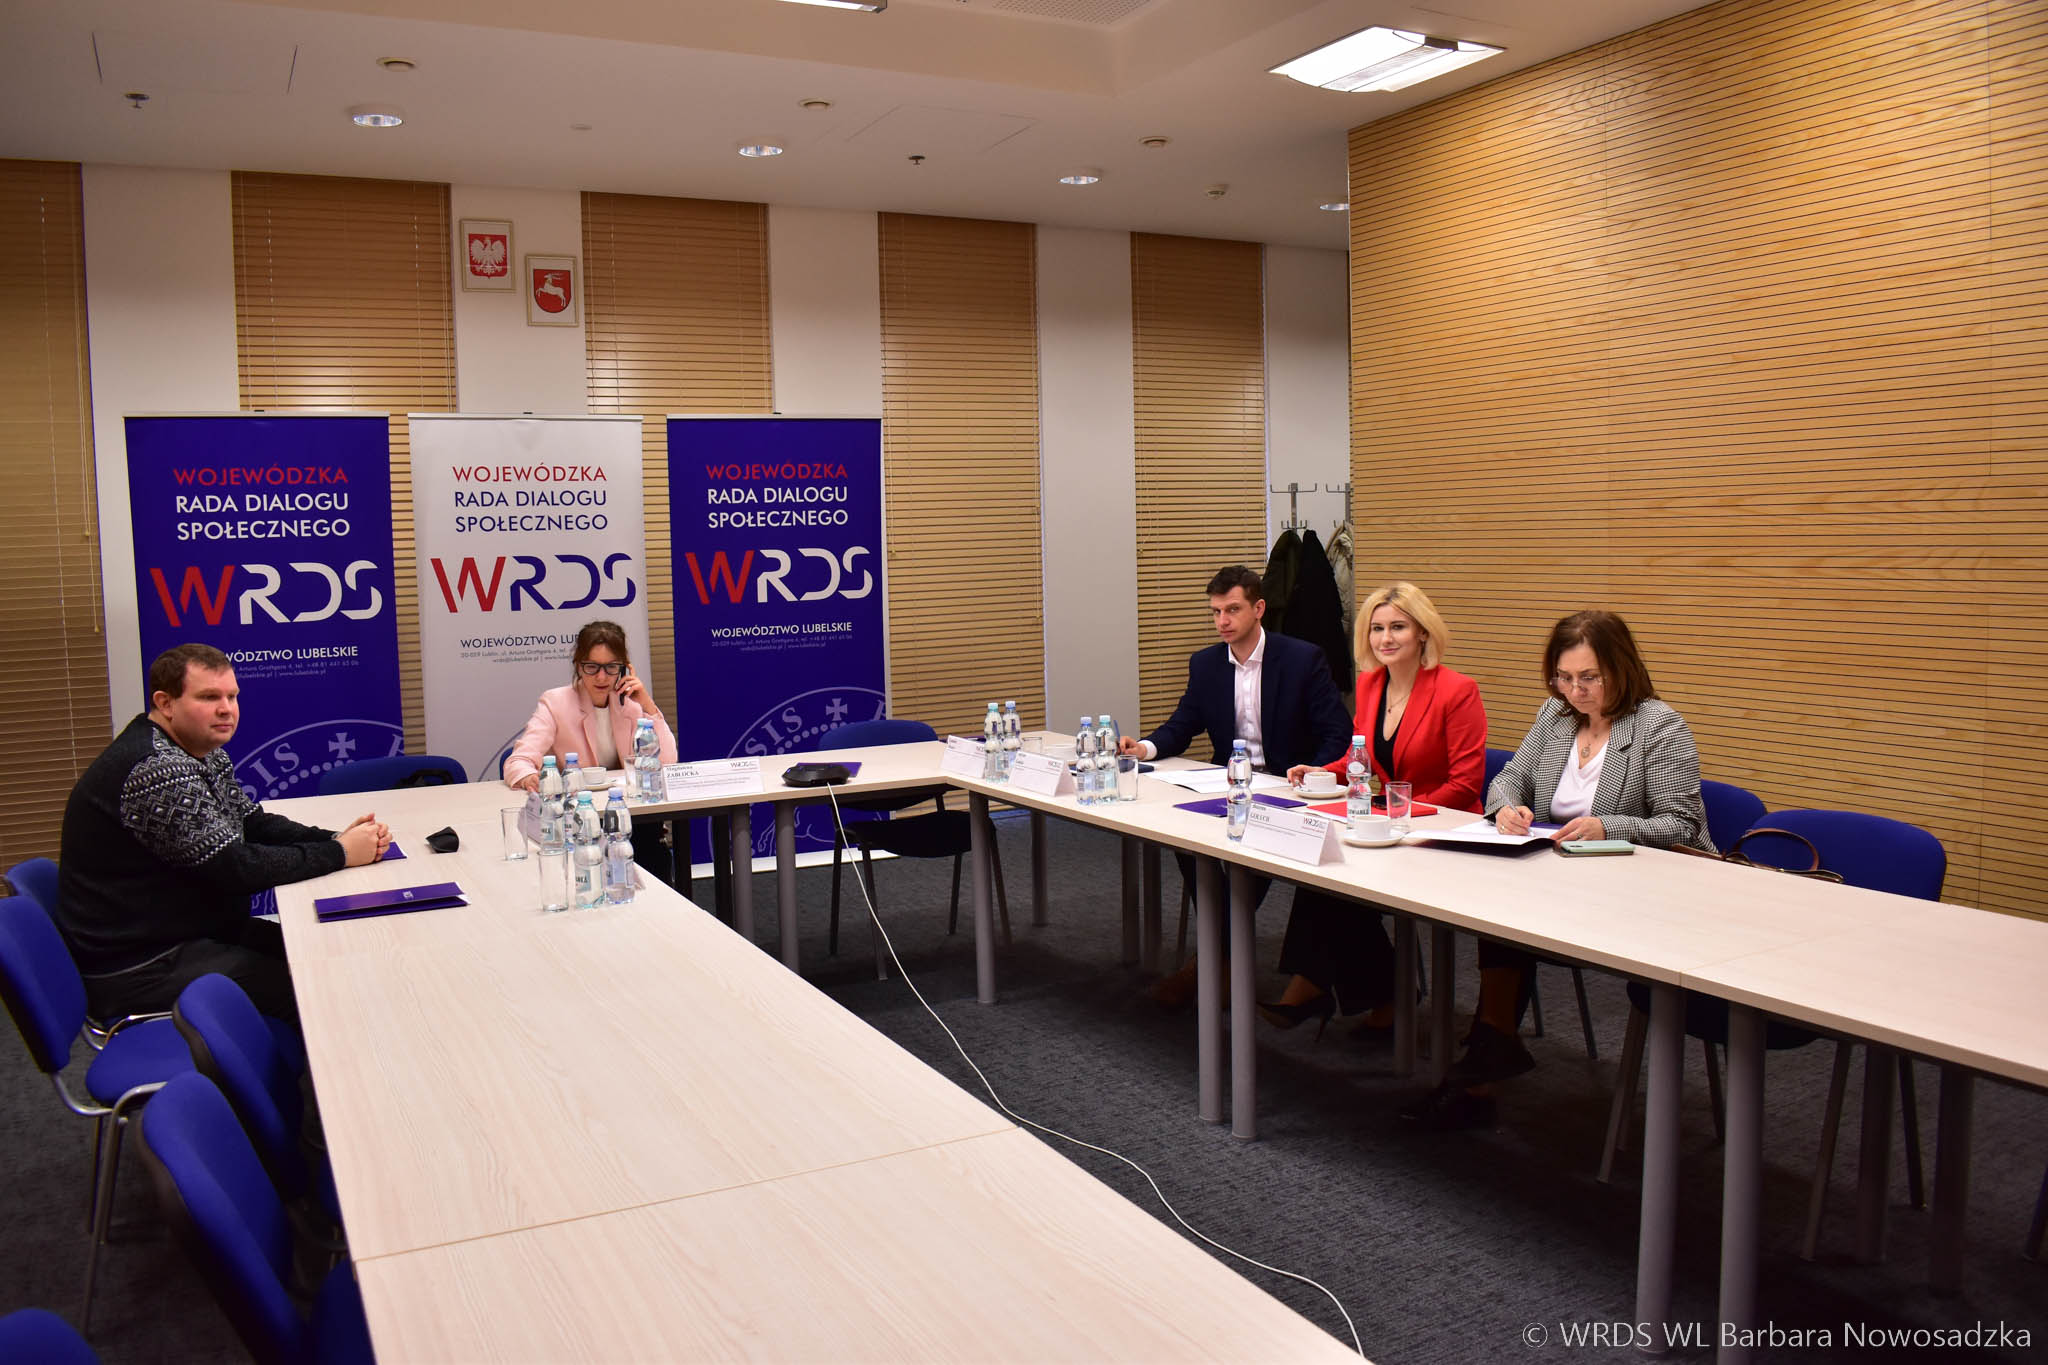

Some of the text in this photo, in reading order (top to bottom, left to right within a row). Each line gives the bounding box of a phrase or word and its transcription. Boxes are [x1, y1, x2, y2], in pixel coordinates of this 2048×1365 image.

[173, 463, 349, 486] WOJEWÓDZKA
[452, 462, 607, 482] WOJEWÓDZKA
[706, 459, 849, 480] WOJEWÓDZKA
[176, 493, 349, 513] RADA DIALOGU
[455, 490, 607, 508] RADA DIALOGU
[707, 486, 848, 505] RADA DIALOGU
[455, 514, 608, 533] SPOŁECZNEGO
[708, 509, 849, 529] SPOŁECZNEGO
[177, 518, 350, 541] SPOŁECZNEGO
[430, 553, 637, 613] WRDS
[685, 546, 873, 605] WRDS
[150, 560, 383, 628] WRDS
[711, 622, 852, 638] WOJEWÓDZTWO LUBELSKIE
[460, 634, 558, 649] WOJEWÓDZTWO
[225, 646, 358, 663] WÓDZTWO LUBELSKIE
